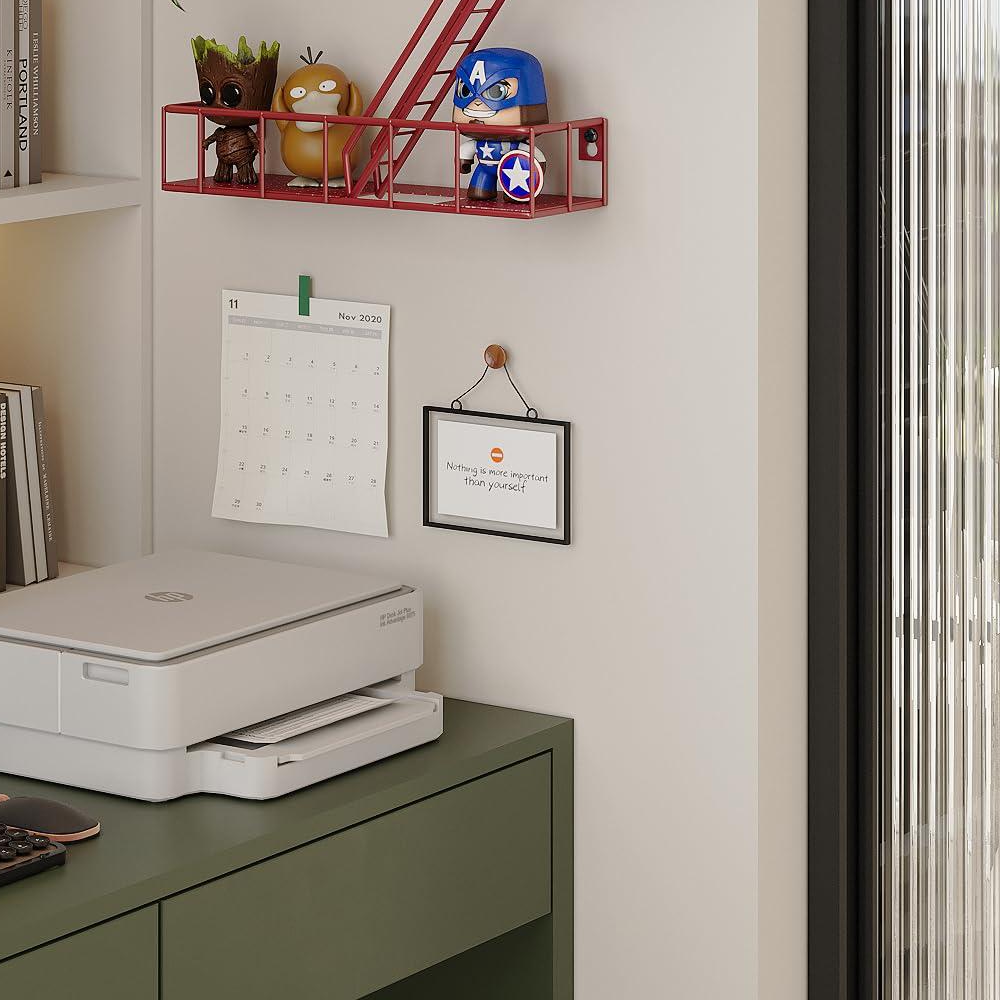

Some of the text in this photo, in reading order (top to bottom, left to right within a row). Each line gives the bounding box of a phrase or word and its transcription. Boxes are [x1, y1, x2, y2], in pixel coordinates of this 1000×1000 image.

[470, 60, 486, 86] A
[19, 58, 28, 152] PORTLAND
[229, 299, 238, 309] 11
[338, 312, 382, 324] Nov 2020
[446, 461, 548, 483] Nothing is more important
[464, 476, 528, 494] than yourself
